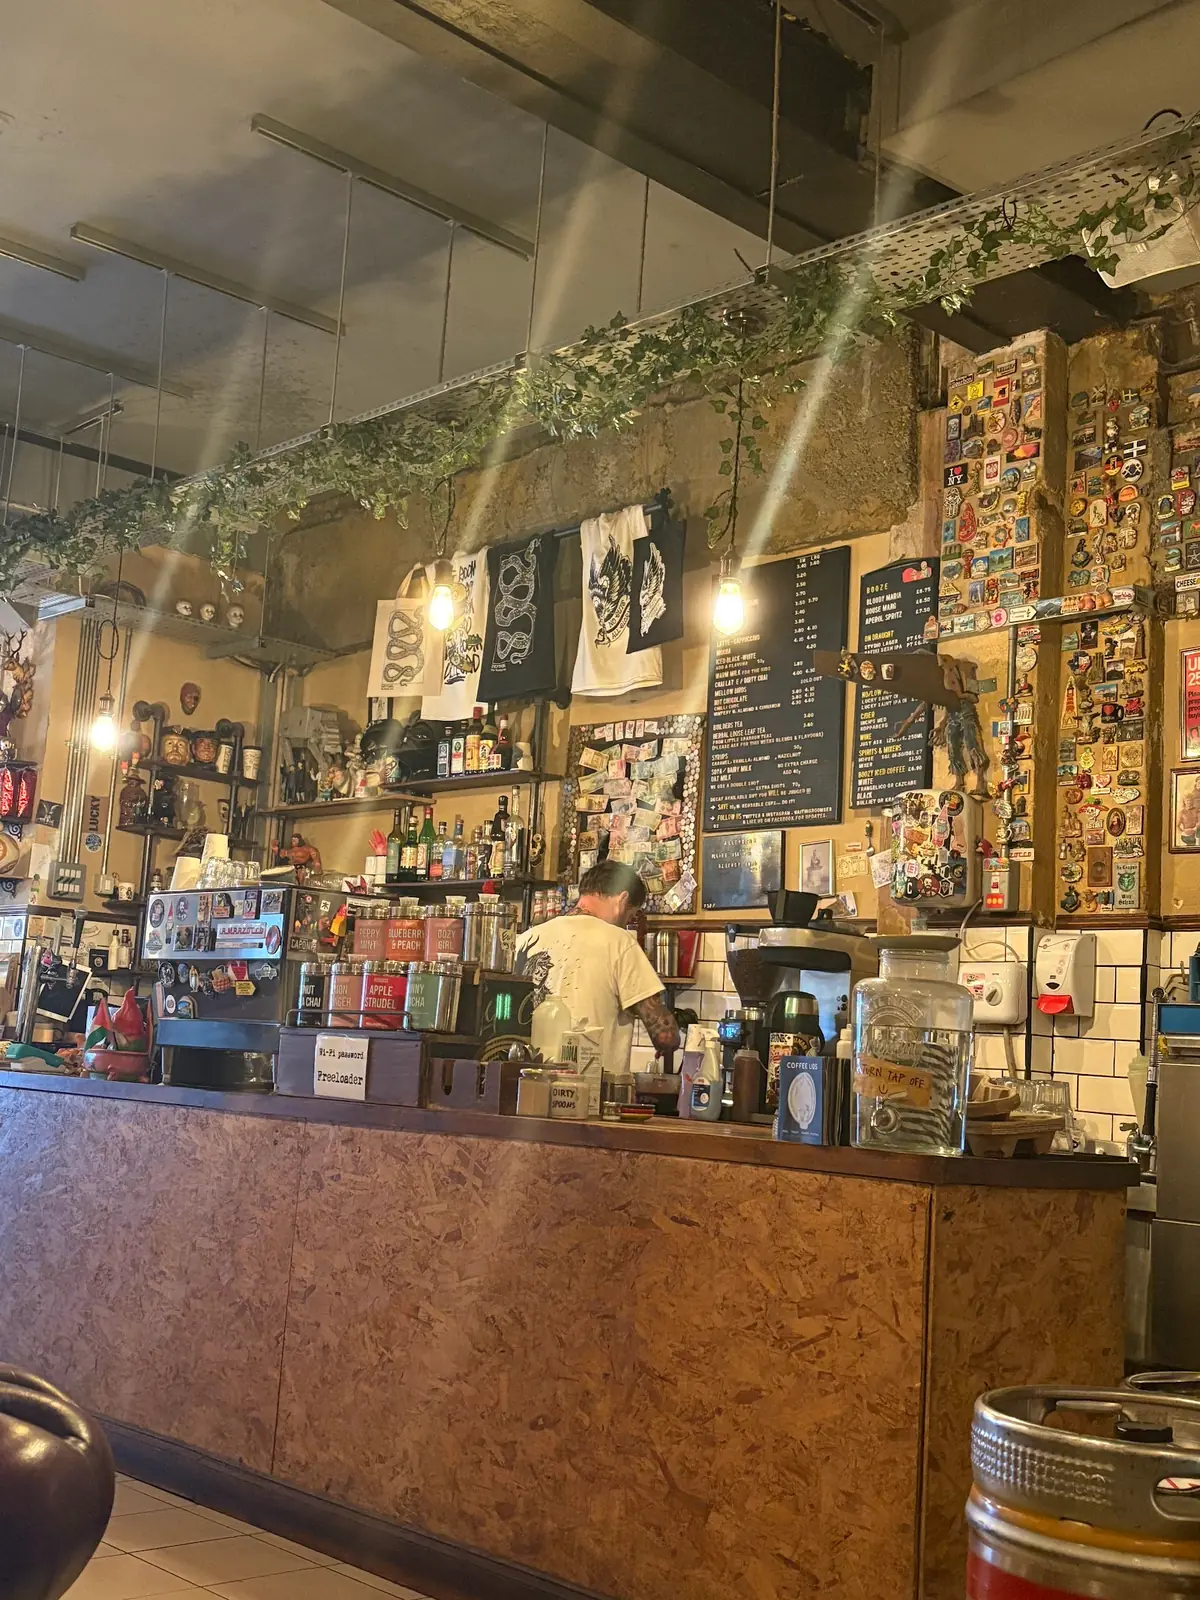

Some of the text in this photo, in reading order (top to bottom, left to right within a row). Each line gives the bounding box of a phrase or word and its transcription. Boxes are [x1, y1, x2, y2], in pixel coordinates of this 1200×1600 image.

[950, 468, 953, 476] I
[948, 474, 963, 486] NY
[1177, 578, 1196, 588] CHEESE
[867, 583, 888, 594] BOOZE
[867, 596, 884, 605] BLOODY
[886, 592, 901, 601] MARIA
[866, 606, 881, 615] HOUSE
[865, 615, 884, 625] APEROL
[885, 611, 902, 621] SPRITZ
[872, 630, 894, 640] DRAUGHT
[861, 711, 875, 719] CIDER
[887, 766, 905, 774] COFFEE
[89, 796, 100, 831] LUCKY
[360, 929, 380, 938] PEPPY
[389, 929, 424, 938] BLUEBERRY
[398, 941, 420, 950] PEACH
[438, 941, 454, 949] GIRL
[369, 985, 393, 996] APPLE
[306, 997, 320, 1007] CHAI
[365, 997, 396, 1009] STRUDEL
[338, 1051, 364, 1059] password
[786, 1061, 807, 1070] COFFEE
[317, 1071, 363, 1085] Freeloader
[862, 1064, 925, 1088] TURN TAP OFF
[553, 1088, 575, 1098] DIRTY
[552, 1100, 576, 1109] SPOONS
